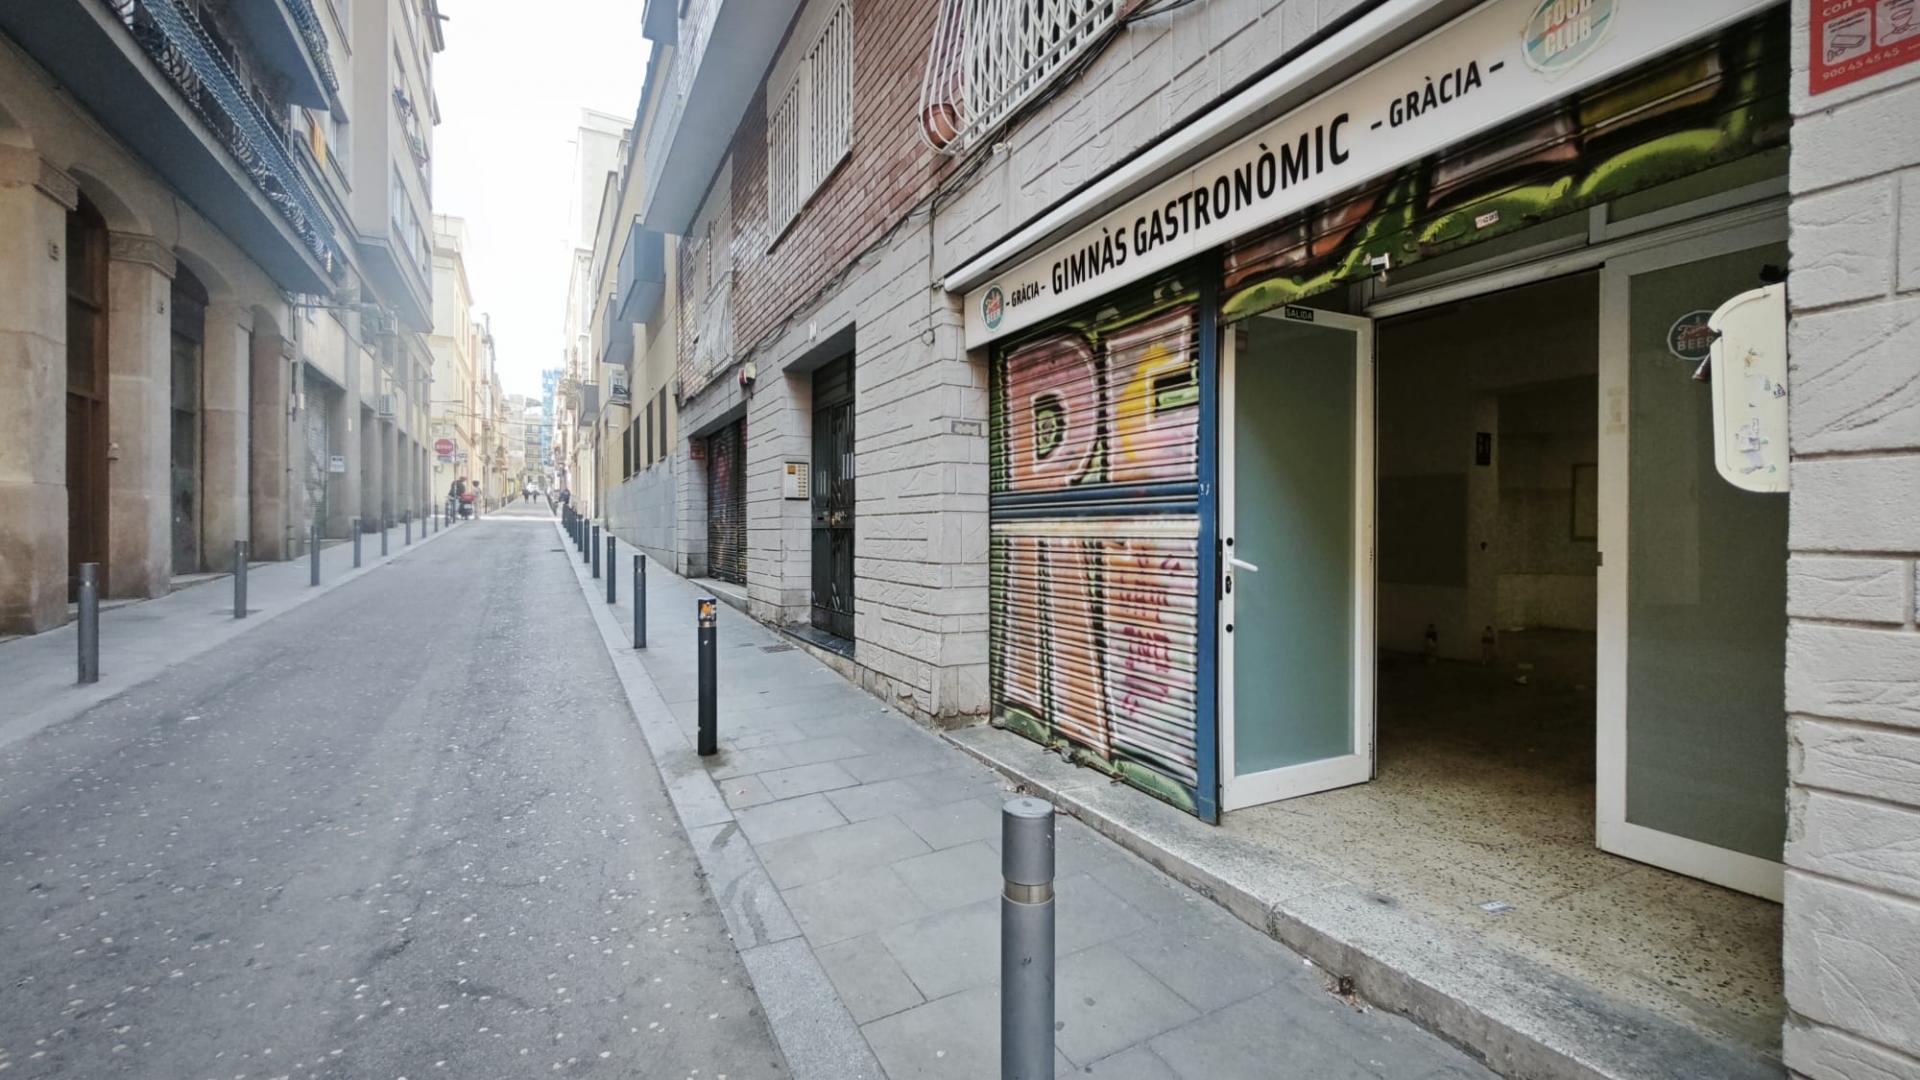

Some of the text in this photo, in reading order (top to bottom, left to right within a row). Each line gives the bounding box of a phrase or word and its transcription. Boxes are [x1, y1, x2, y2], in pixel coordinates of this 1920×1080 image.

[1544, 15, 1592, 57] CLUB
[1822, 66, 1846, 80] 900
[1847, 60, 1864, 71] 45
[1865, 53, 1881, 64] 45
[1883, 47, 1900, 59] 45
[1012, 281, 1039, 307] GRÀCIA
[1051, 227, 1128, 296] GIMNÀS
[1133, 112, 1350, 257] GASTRONÒMIC
[1389, 60, 1482, 128] GRÀCIA
[1286, 308, 1312, 321] SALIDA
